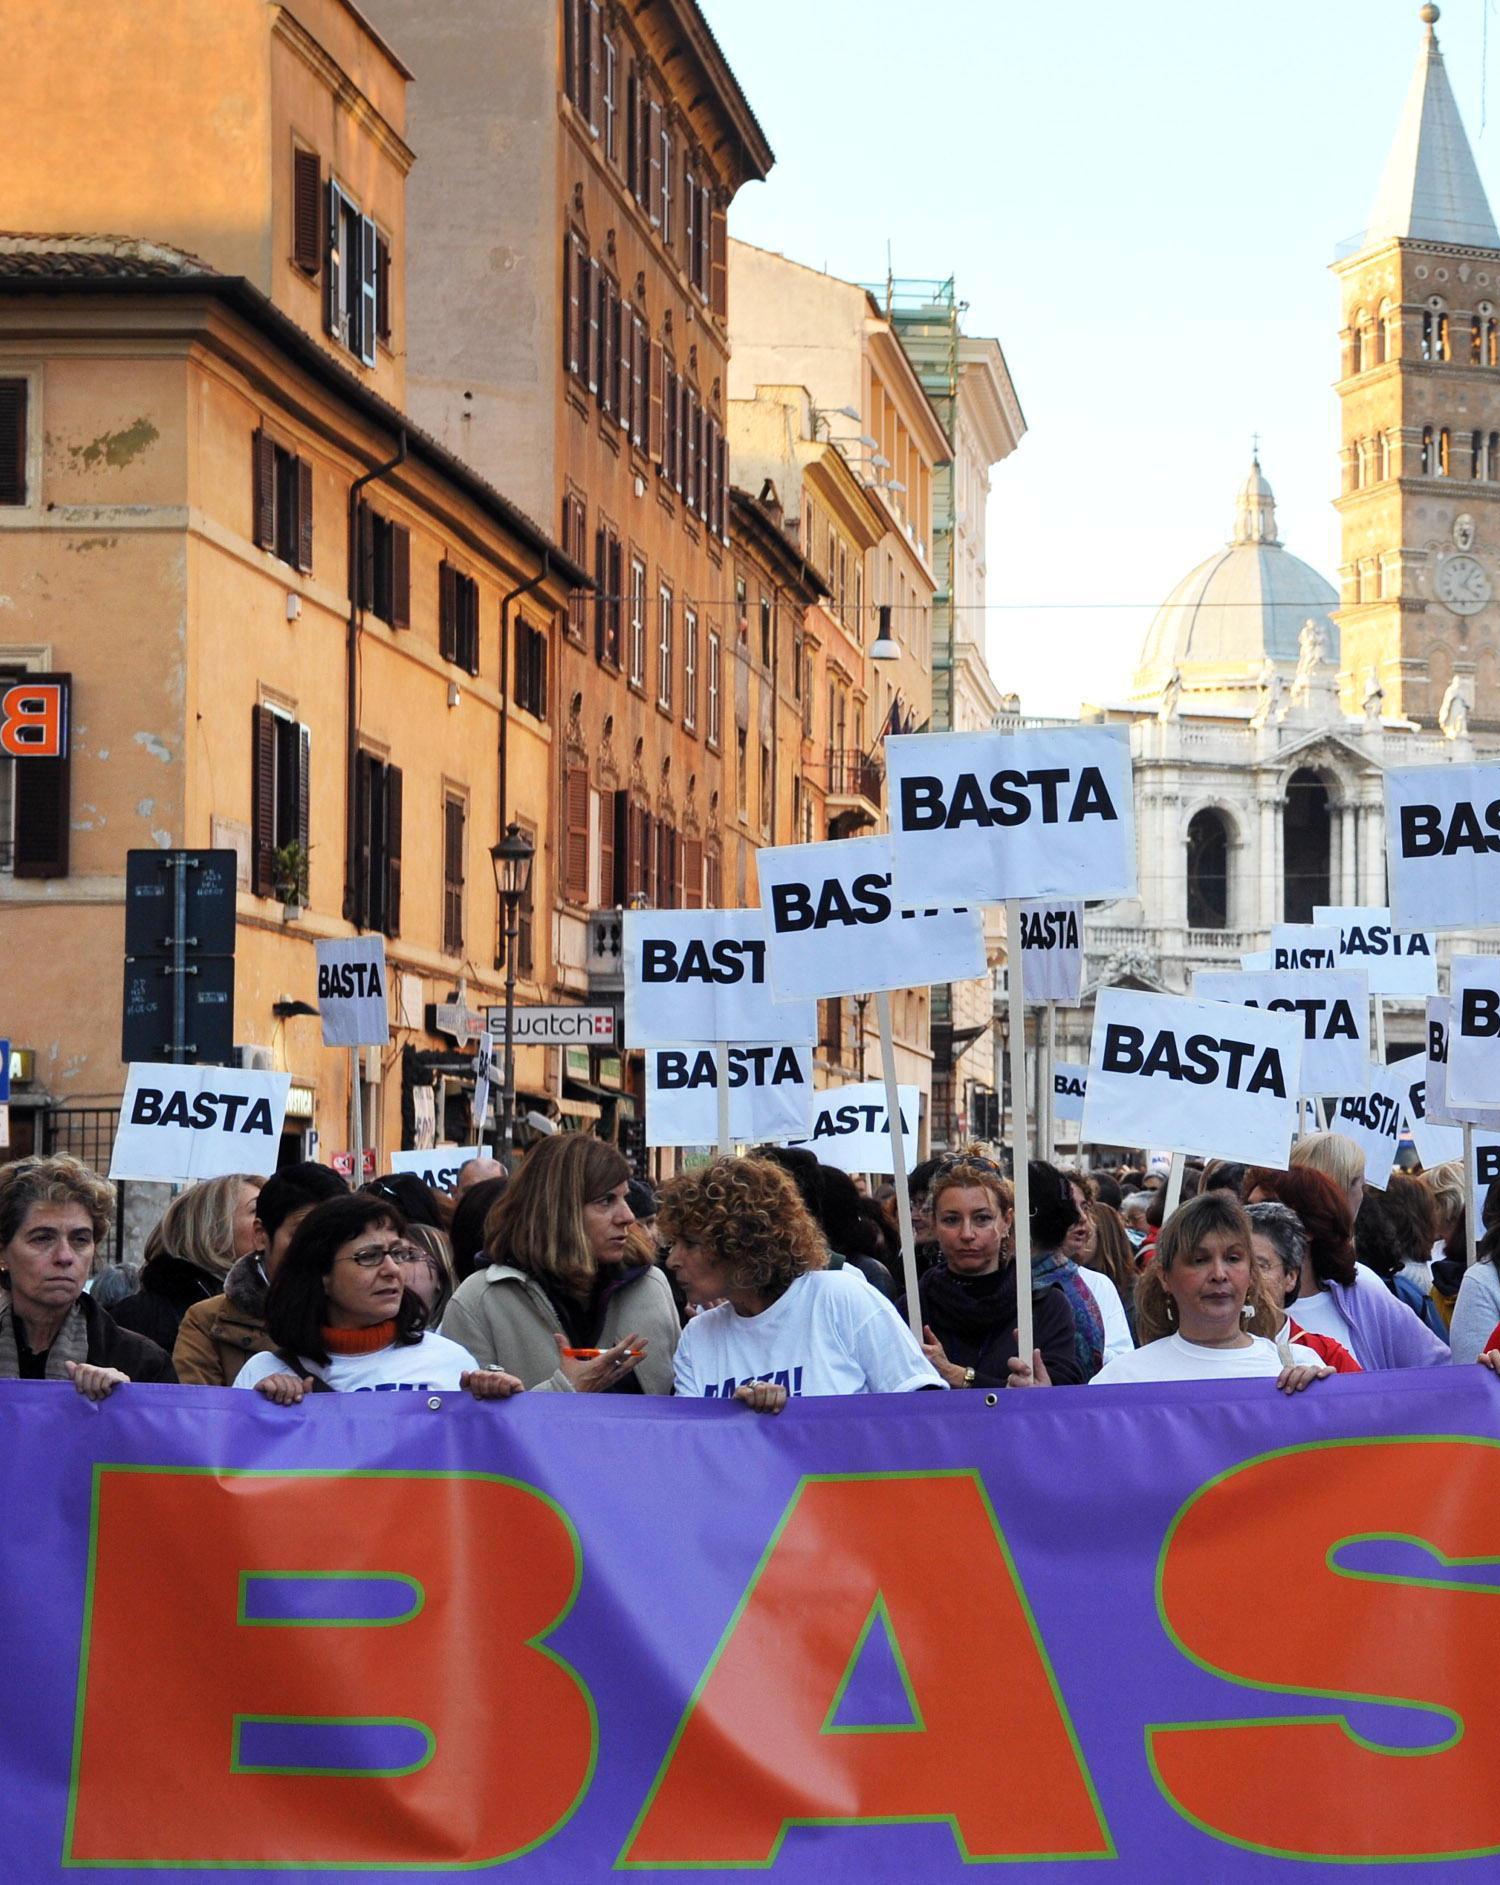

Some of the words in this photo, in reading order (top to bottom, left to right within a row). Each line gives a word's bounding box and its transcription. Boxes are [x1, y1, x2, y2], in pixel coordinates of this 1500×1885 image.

[901, 767, 1118, 831] BASTA
[772, 873, 967, 933] BAS
[318, 962, 383, 999] BASTA
[641, 939, 766, 984] BAST
[490, 1013, 592, 1035] swatch
[657, 1047, 804, 1089] BASTA
[1102, 1023, 1287, 1098] BASTA
[130, 1088, 273, 1135] BASTA
[788, 1105, 909, 1146] ASTA
[1340, 1092, 1400, 1140] BASTA
